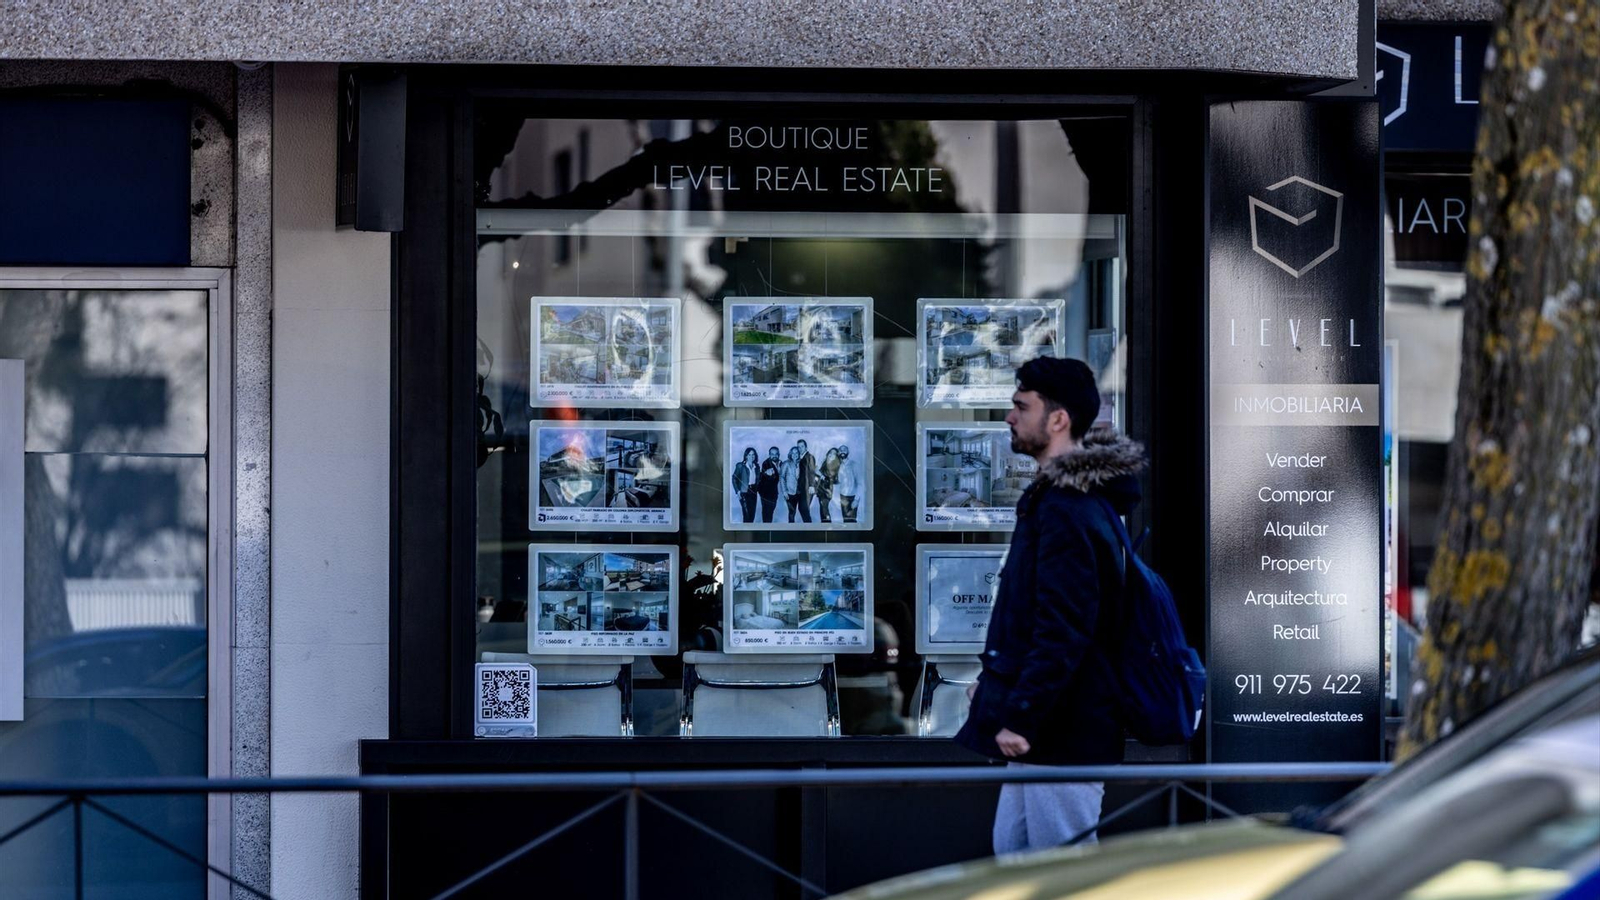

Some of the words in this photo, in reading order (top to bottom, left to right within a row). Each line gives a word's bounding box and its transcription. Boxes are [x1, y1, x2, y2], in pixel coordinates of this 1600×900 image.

[729, 126, 868, 149] BOUTIQUE
[653, 165, 741, 191] LEVEL
[755, 166, 828, 191] REAL
[843, 167, 943, 192] ESTATE
[1389, 197, 1467, 234] IAR
[1231, 318, 1361, 348] LEVEL
[1234, 397, 1364, 413] INMOBILIARIA
[1266, 452, 1327, 468] Vender
[1258, 486, 1335, 505] Comprar
[1263, 521, 1329, 541] Alquilar
[1261, 555, 1332, 574] Property
[952, 594, 976, 604] OFF
[1244, 590, 1348, 608] Arquitectura
[1273, 624, 1320, 640] Retail
[1235, 674, 1262, 695] 911
[1273, 674, 1312, 695] 975
[1322, 674, 1362, 695] 422
[1233, 711, 1363, 723] www.levelrealestate.es
